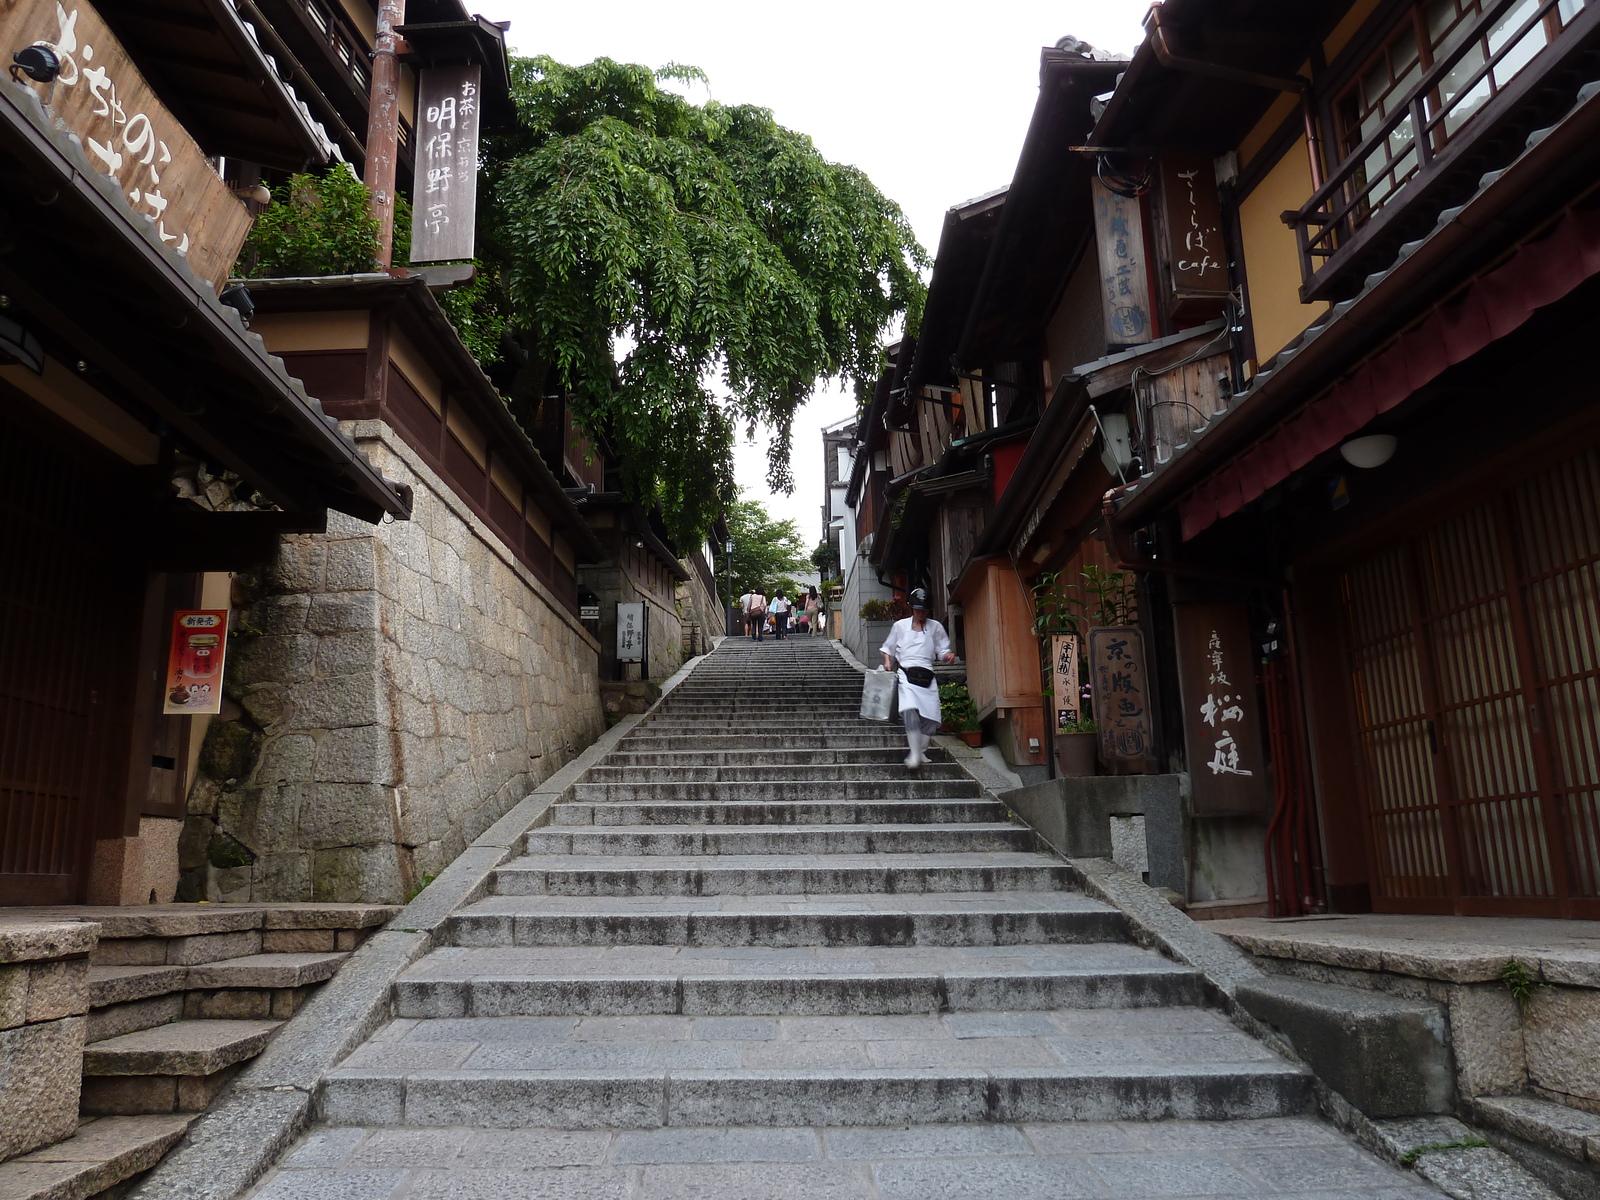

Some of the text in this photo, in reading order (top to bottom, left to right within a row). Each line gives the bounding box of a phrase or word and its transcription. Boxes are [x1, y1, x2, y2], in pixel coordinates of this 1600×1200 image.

[424, 97, 456, 234] 明保野亭
[1177, 170, 1217, 252] さくらば
[1178, 256, 1221, 276] cafe
[186, 616, 215, 626] 新発売
